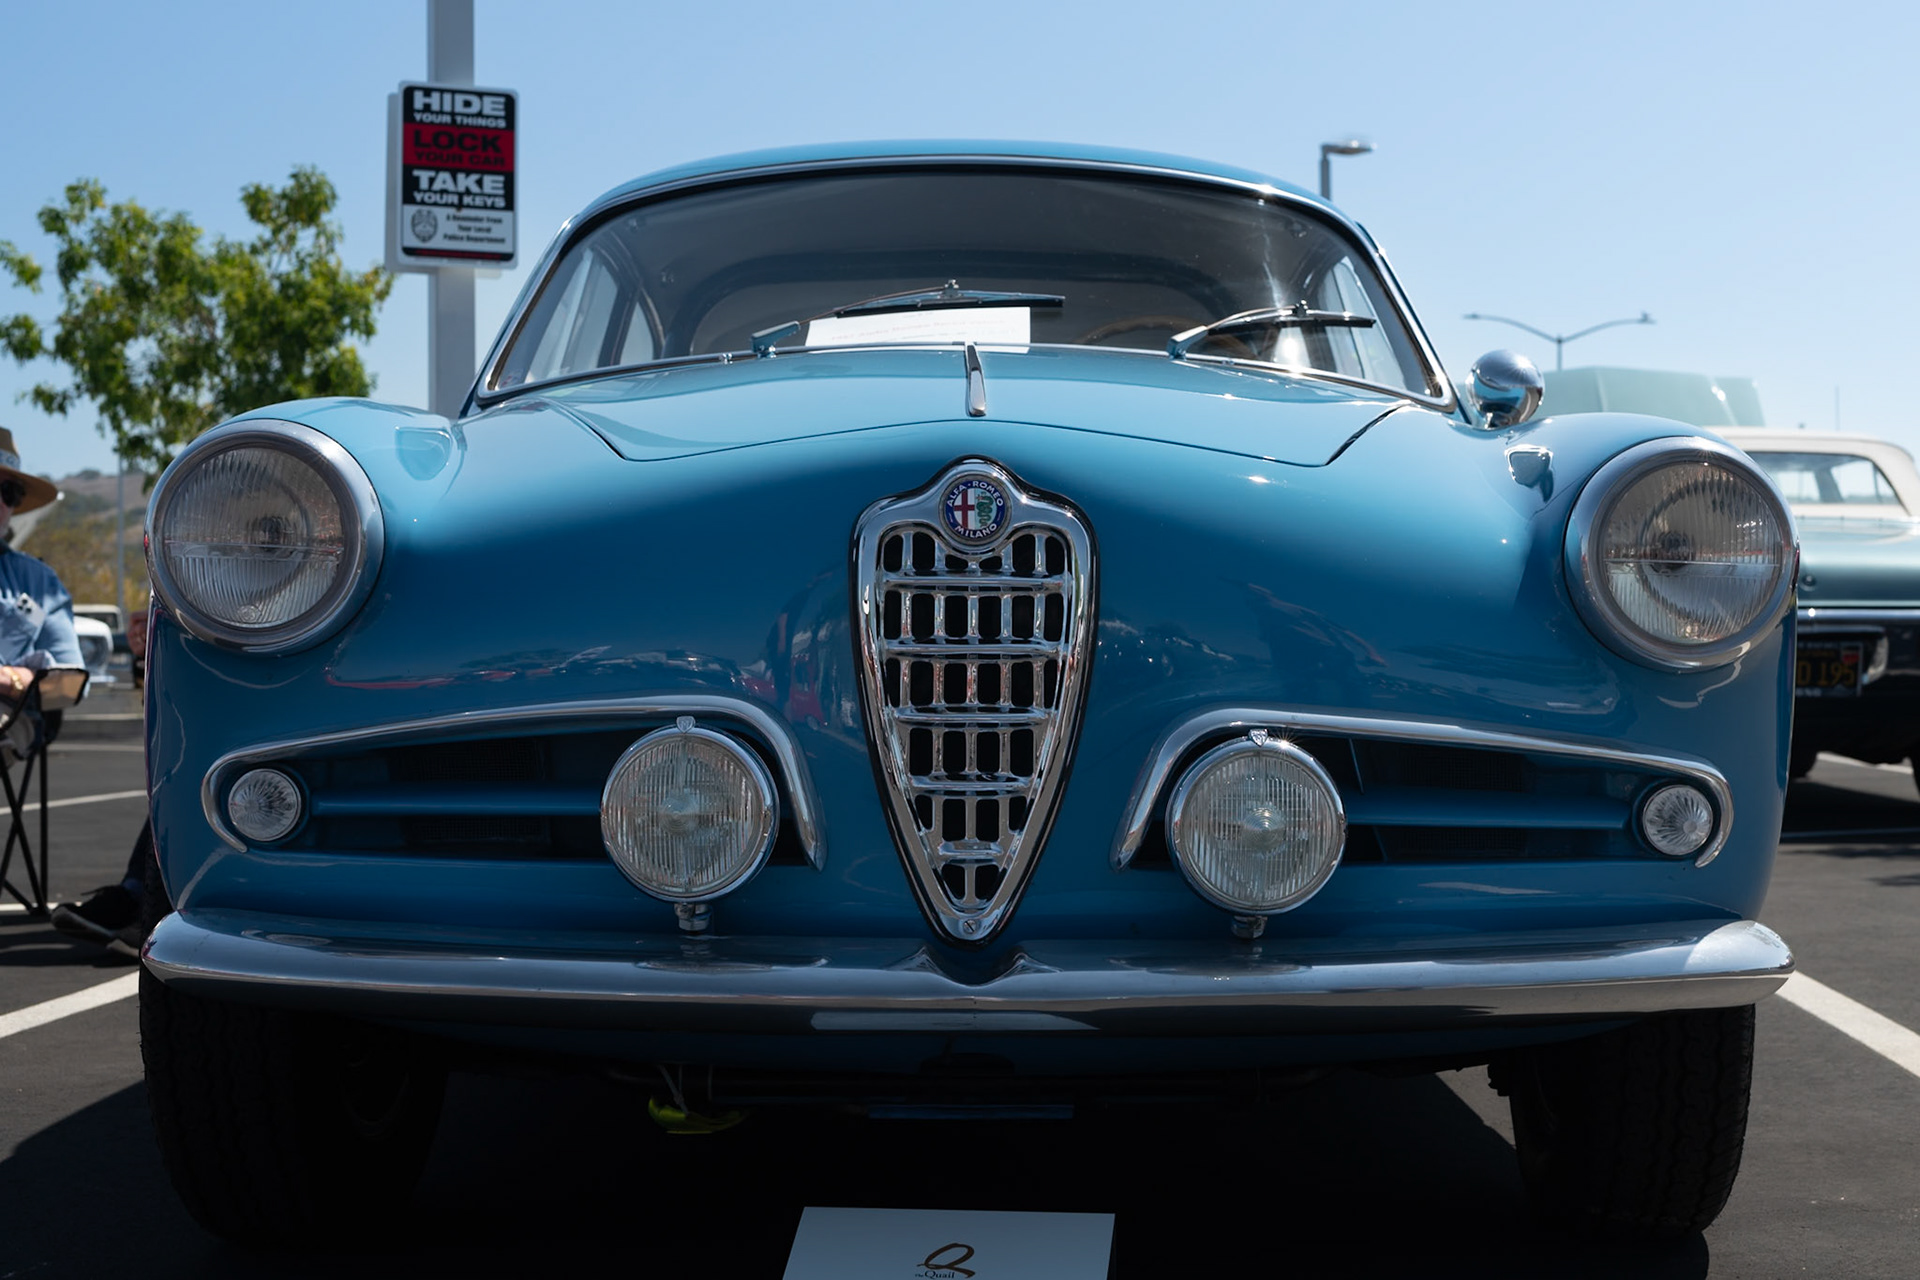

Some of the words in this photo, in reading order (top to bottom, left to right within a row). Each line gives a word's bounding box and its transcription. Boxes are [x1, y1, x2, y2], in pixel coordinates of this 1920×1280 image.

[413, 90, 506, 116] HIDE
[414, 112, 452, 123] YOUR
[455, 115, 506, 128] THINGS
[414, 130, 502, 153] LOCK
[415, 150, 463, 164] YOUR
[469, 153, 505, 167] CAR
[412, 169, 506, 195] TAKE
[413, 191, 459, 205] YOUR
[463, 193, 507, 208] KEYS
[947, 484, 967, 507] ALFA
[972, 480, 1004, 507] ROMEO
[954, 523, 997, 538] MILANO
[924, 1270, 955, 1280] Quail
